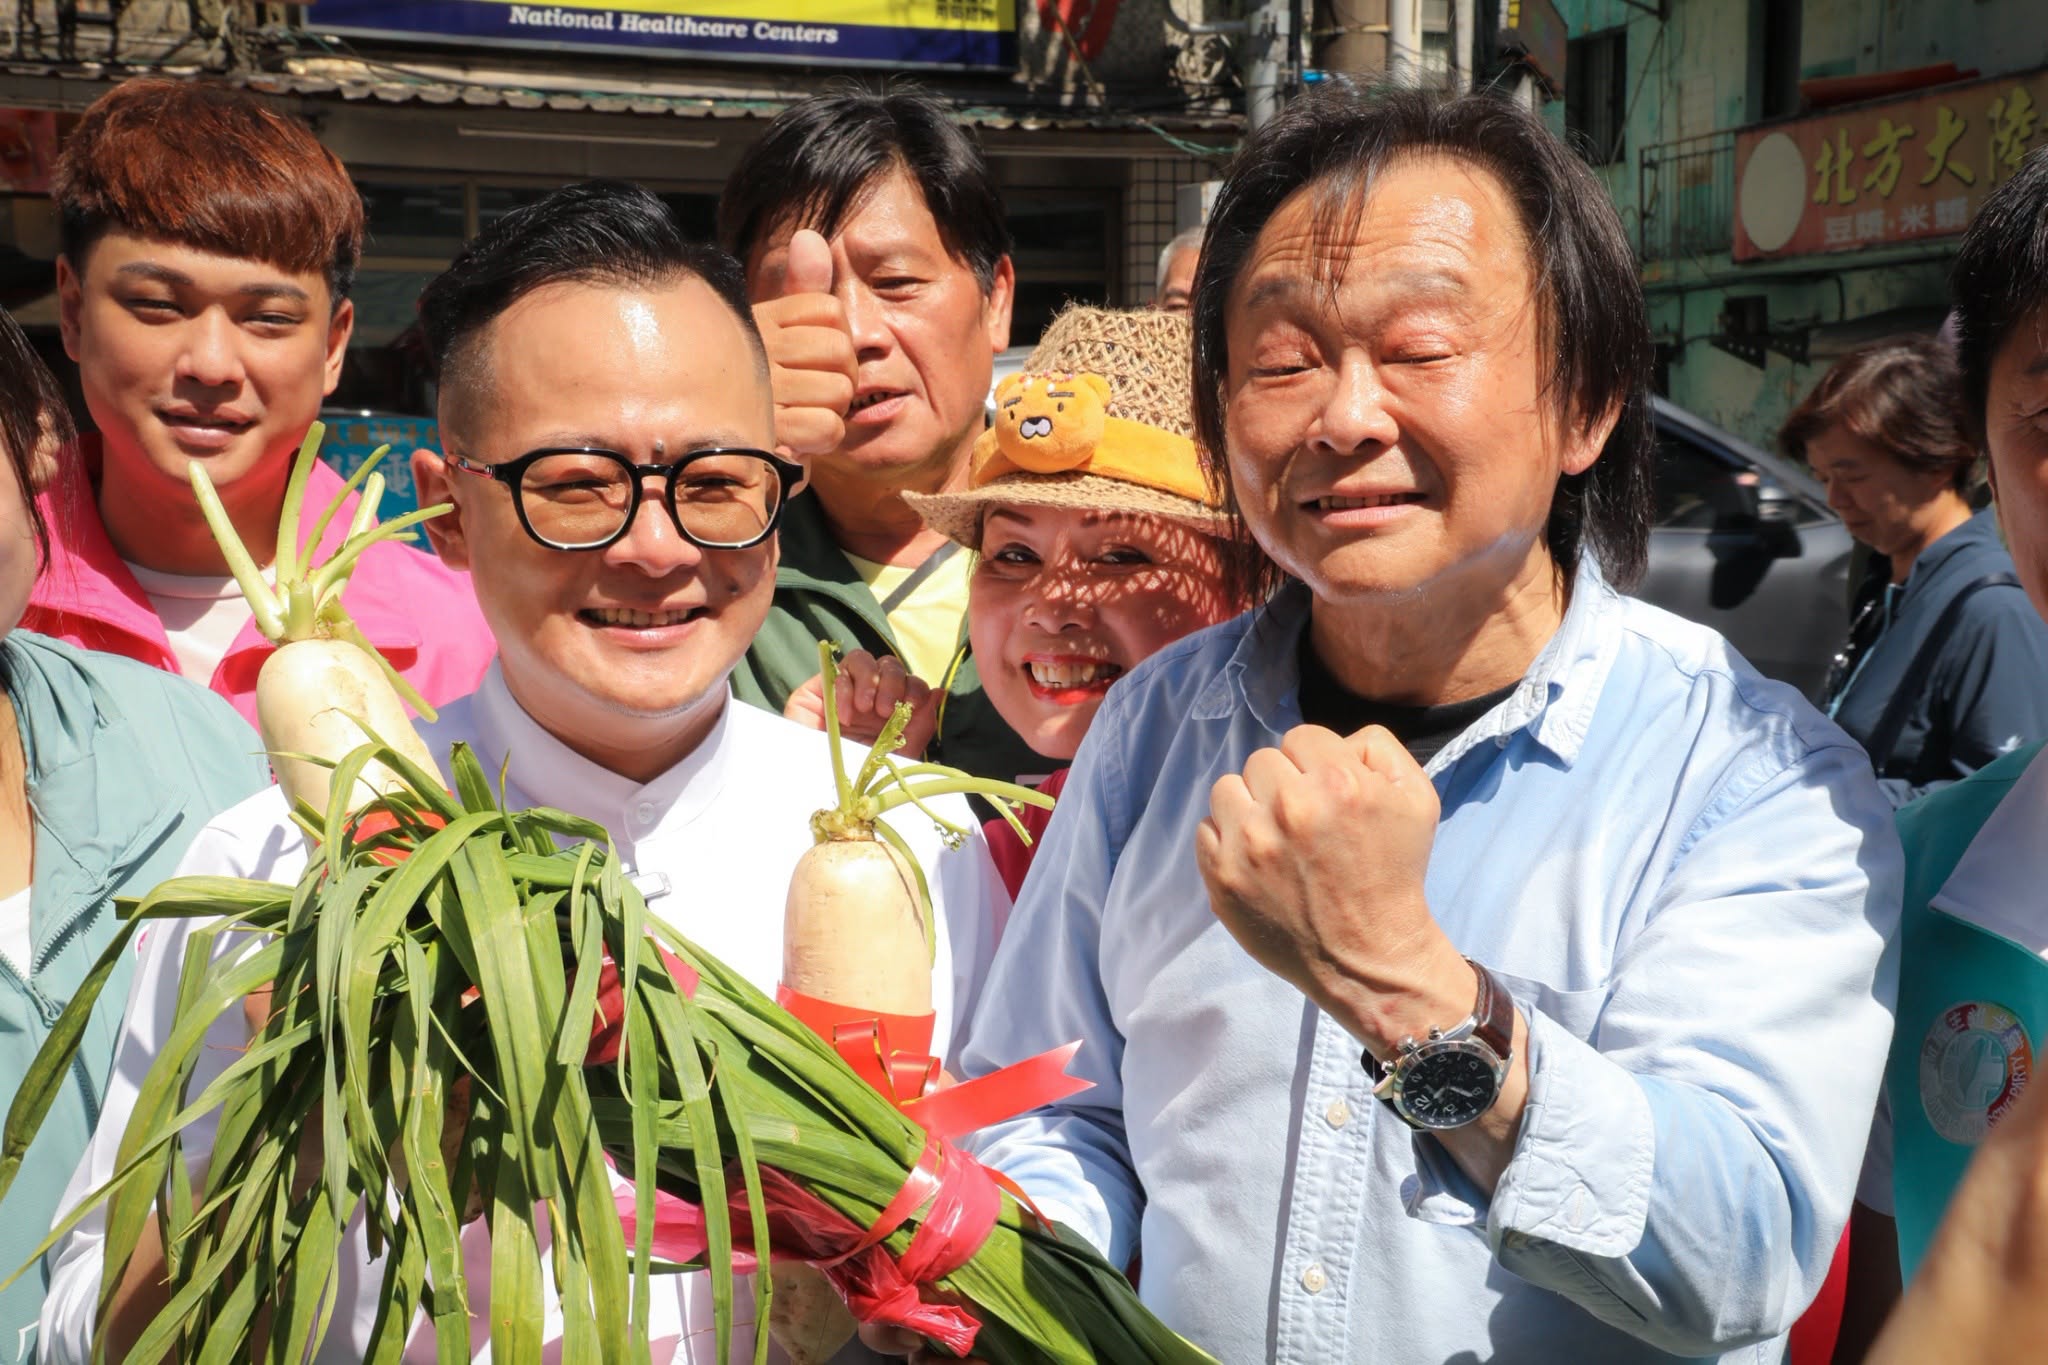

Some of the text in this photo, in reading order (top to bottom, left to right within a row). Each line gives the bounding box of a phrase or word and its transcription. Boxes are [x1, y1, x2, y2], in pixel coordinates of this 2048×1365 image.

[509, 5, 839, 43] National Healthcare Centers
[1812, 85, 2048, 205] 北方大陸
[2010, 1055, 2027, 1097] PARTY
[1414, 1095, 1432, 1111] 12
